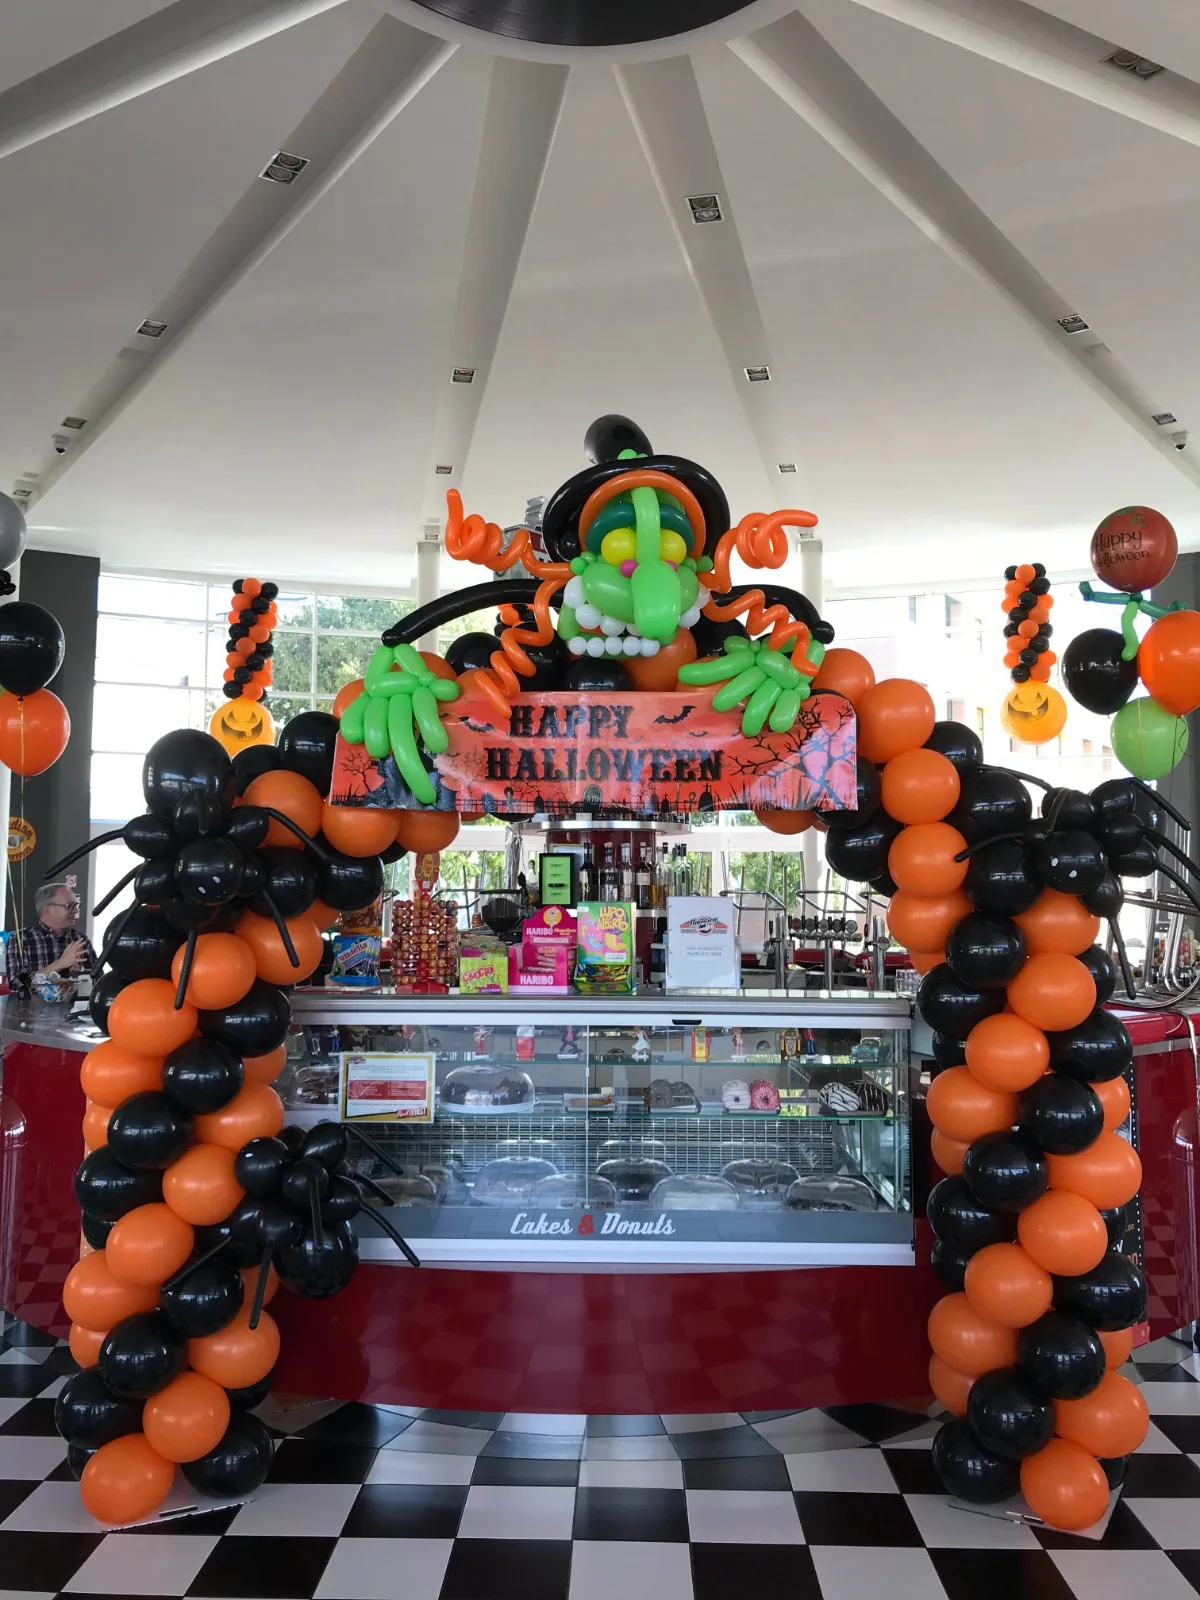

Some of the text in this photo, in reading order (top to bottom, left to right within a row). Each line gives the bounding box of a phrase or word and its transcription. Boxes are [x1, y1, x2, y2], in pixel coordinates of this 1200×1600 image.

[1095, 531, 1142, 551] Happy
[1097, 551, 1149, 567] alloween
[509, 705, 634, 738] HAPPY
[484, 747, 724, 782] HALLOWEEN
[600, 905, 624, 918] LUPO
[526, 927, 553, 936] HARIBO
[597, 916, 628, 931] ALBERTO
[520, 975, 553, 985] HARIBO
[510, 1213, 676, 1236] Cakes & Donuts
